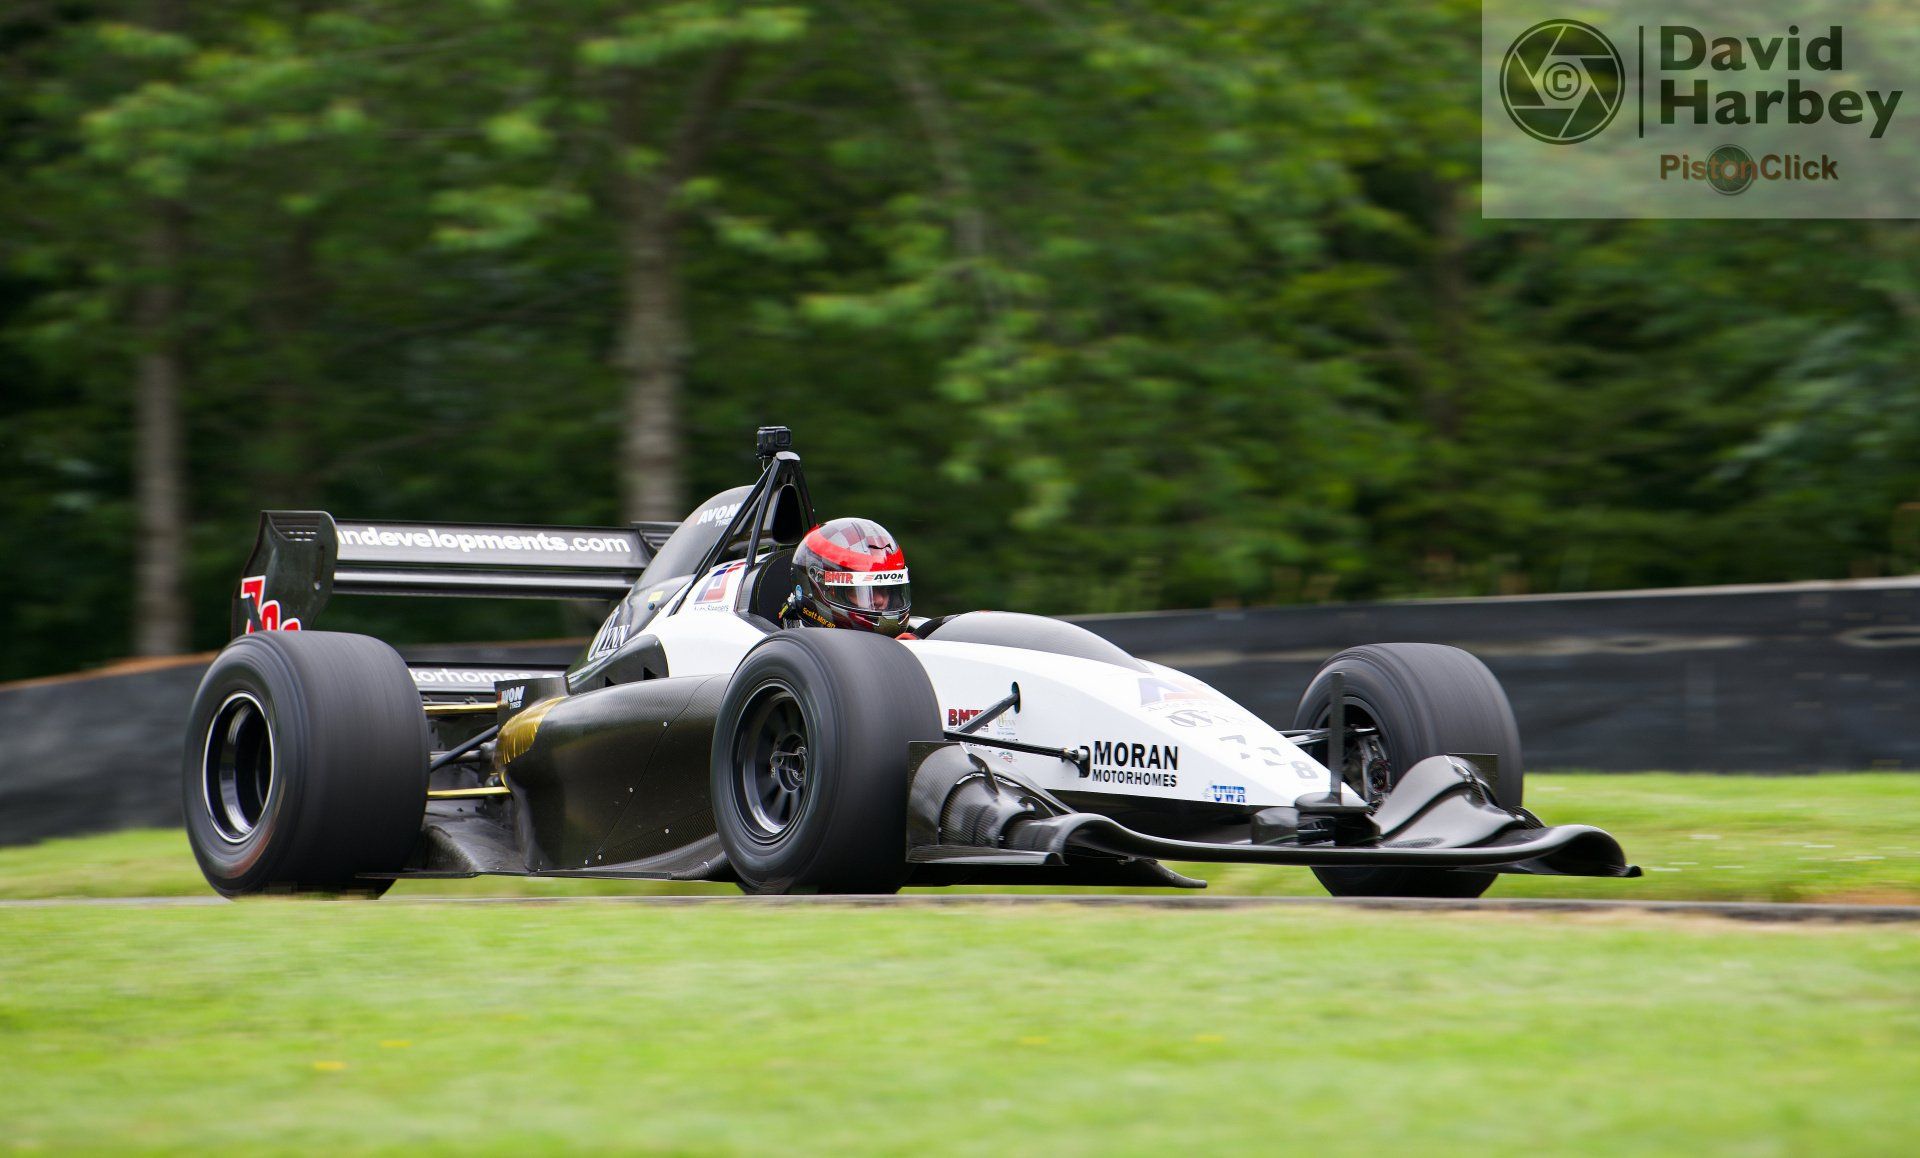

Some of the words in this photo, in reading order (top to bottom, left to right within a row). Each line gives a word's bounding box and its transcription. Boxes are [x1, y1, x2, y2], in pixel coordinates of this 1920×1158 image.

[697, 503, 742, 525] AVON
[1094, 740, 1178, 770] MORAN
[1093, 769, 1177, 787] MOTORHOMES
